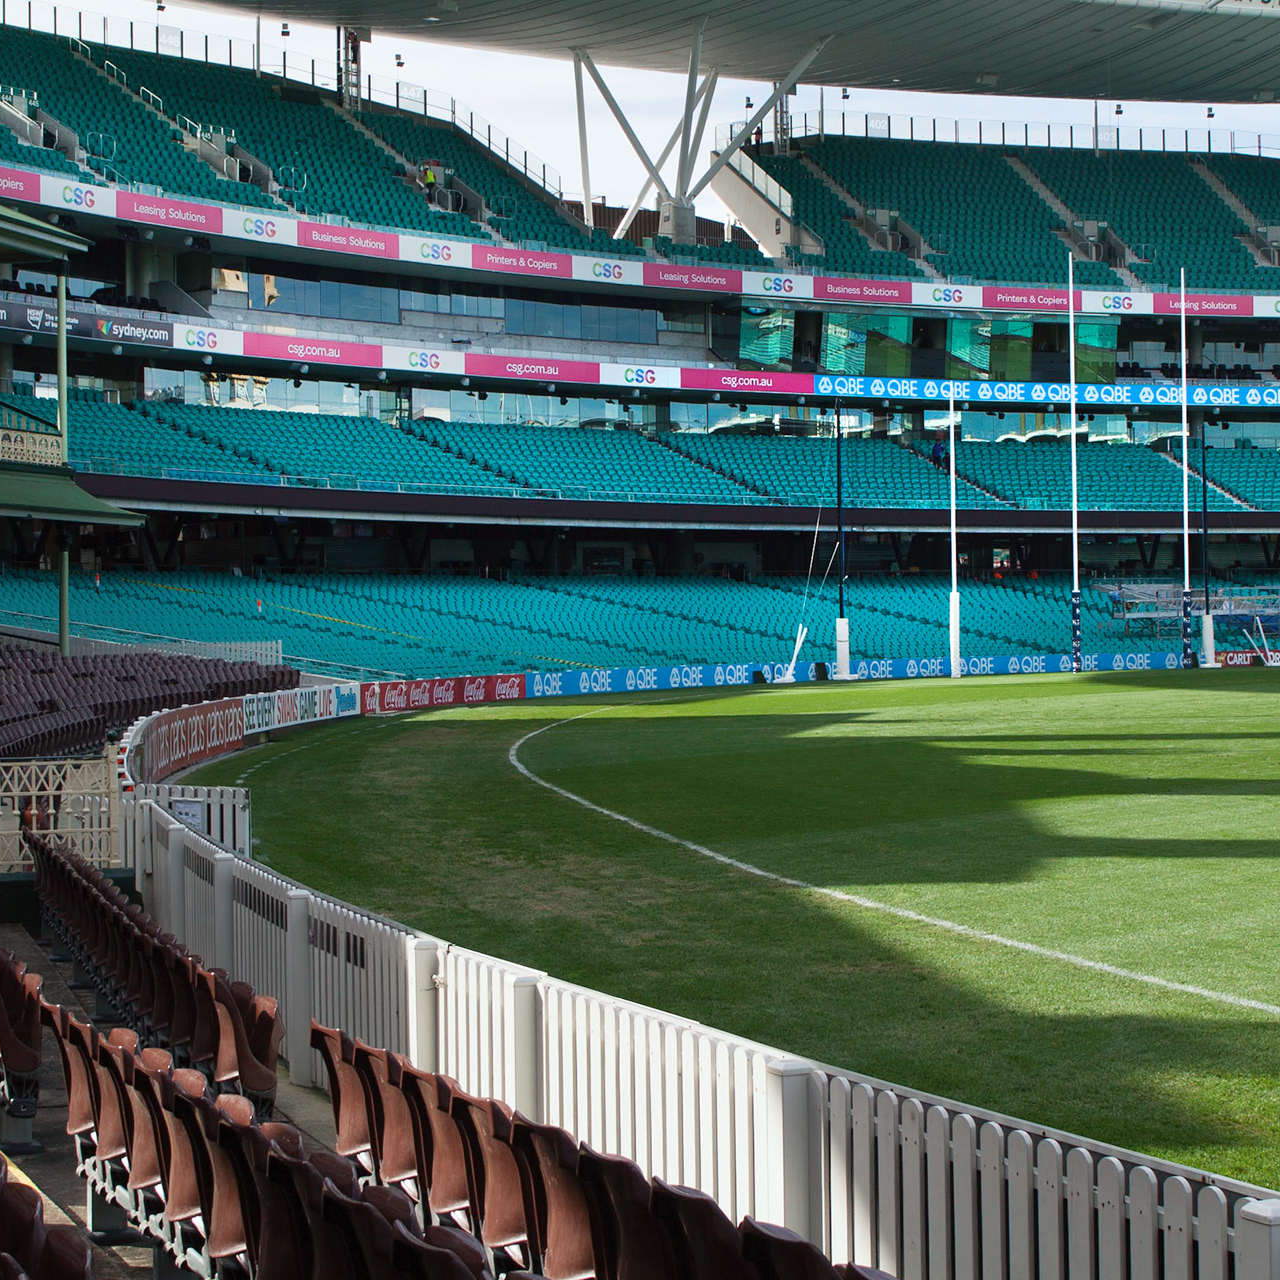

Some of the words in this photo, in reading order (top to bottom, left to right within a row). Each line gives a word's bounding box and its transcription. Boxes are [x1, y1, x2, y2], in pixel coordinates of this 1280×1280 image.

[399, 87, 422, 99] 447
[869, 120, 888, 130] 402
[62, 185, 96, 208] CSG
[134, 202, 166, 219] Leasing
[169, 208, 207, 224] Solutions
[243, 217, 277, 238] CSG
[311, 231, 347, 245] Business
[349, 236, 386, 251] Solutions
[420, 242, 452, 261] CSG
[486, 254, 517, 266] Printers
[518, 258, 526, 266] &
[527, 258, 558, 271] Copiers
[592, 262, 623, 280] CSG
[659, 271, 689, 284] Leasing
[691, 273, 727, 285] Solutions
[762, 277, 794, 293] CSG
[827, 284, 861, 295] Business
[863, 286, 899, 297] Solutions
[932, 288, 963, 303] CSG
[997, 293, 1027, 304] Printers
[1029, 296, 1036, 304] &
[1037, 296, 1067, 306] Copiers
[1102, 295, 1133, 310] CSG
[1169, 300, 1199, 310] Lesing
[1201, 300, 1237, 311] Solutions
[113, 323, 169, 341] sydney.com
[185, 329, 217, 349] CSG
[287, 343, 340, 358] csg.com.au
[408, 351, 440, 369] CSG
[506, 362, 559, 375] csg.com.au
[624, 368, 655, 384] CSG
[721, 375, 772, 387] csg.com.au
[835, 377, 864, 395] QBE
[887, 379, 917, 397] QBE
[994, 383, 1025, 400] QBE
[1101, 386, 1131, 403] QBE
[1210, 388, 1240, 404] QBE
[920, 657, 944, 676] QBE
[969, 657, 994, 674] QBE
[1022, 656, 1046, 673] QBE
[1126, 654, 1151, 670] QBE
[1227, 652, 1261, 666] CARLT
[682, 666, 703, 687] QBE
[727, 665, 749, 685] QBE
[870, 660, 893, 679] QBE
[543, 674, 563, 695] QBE
[590, 672, 612, 692] QBE
[636, 669, 658, 689] QBE
[244, 698, 256, 731] SEE
[257, 695, 276, 728] EVERY
[277, 692, 298, 724] SWANS
[299, 690, 318, 720] GAME
[319, 689, 333, 717] LIVE
